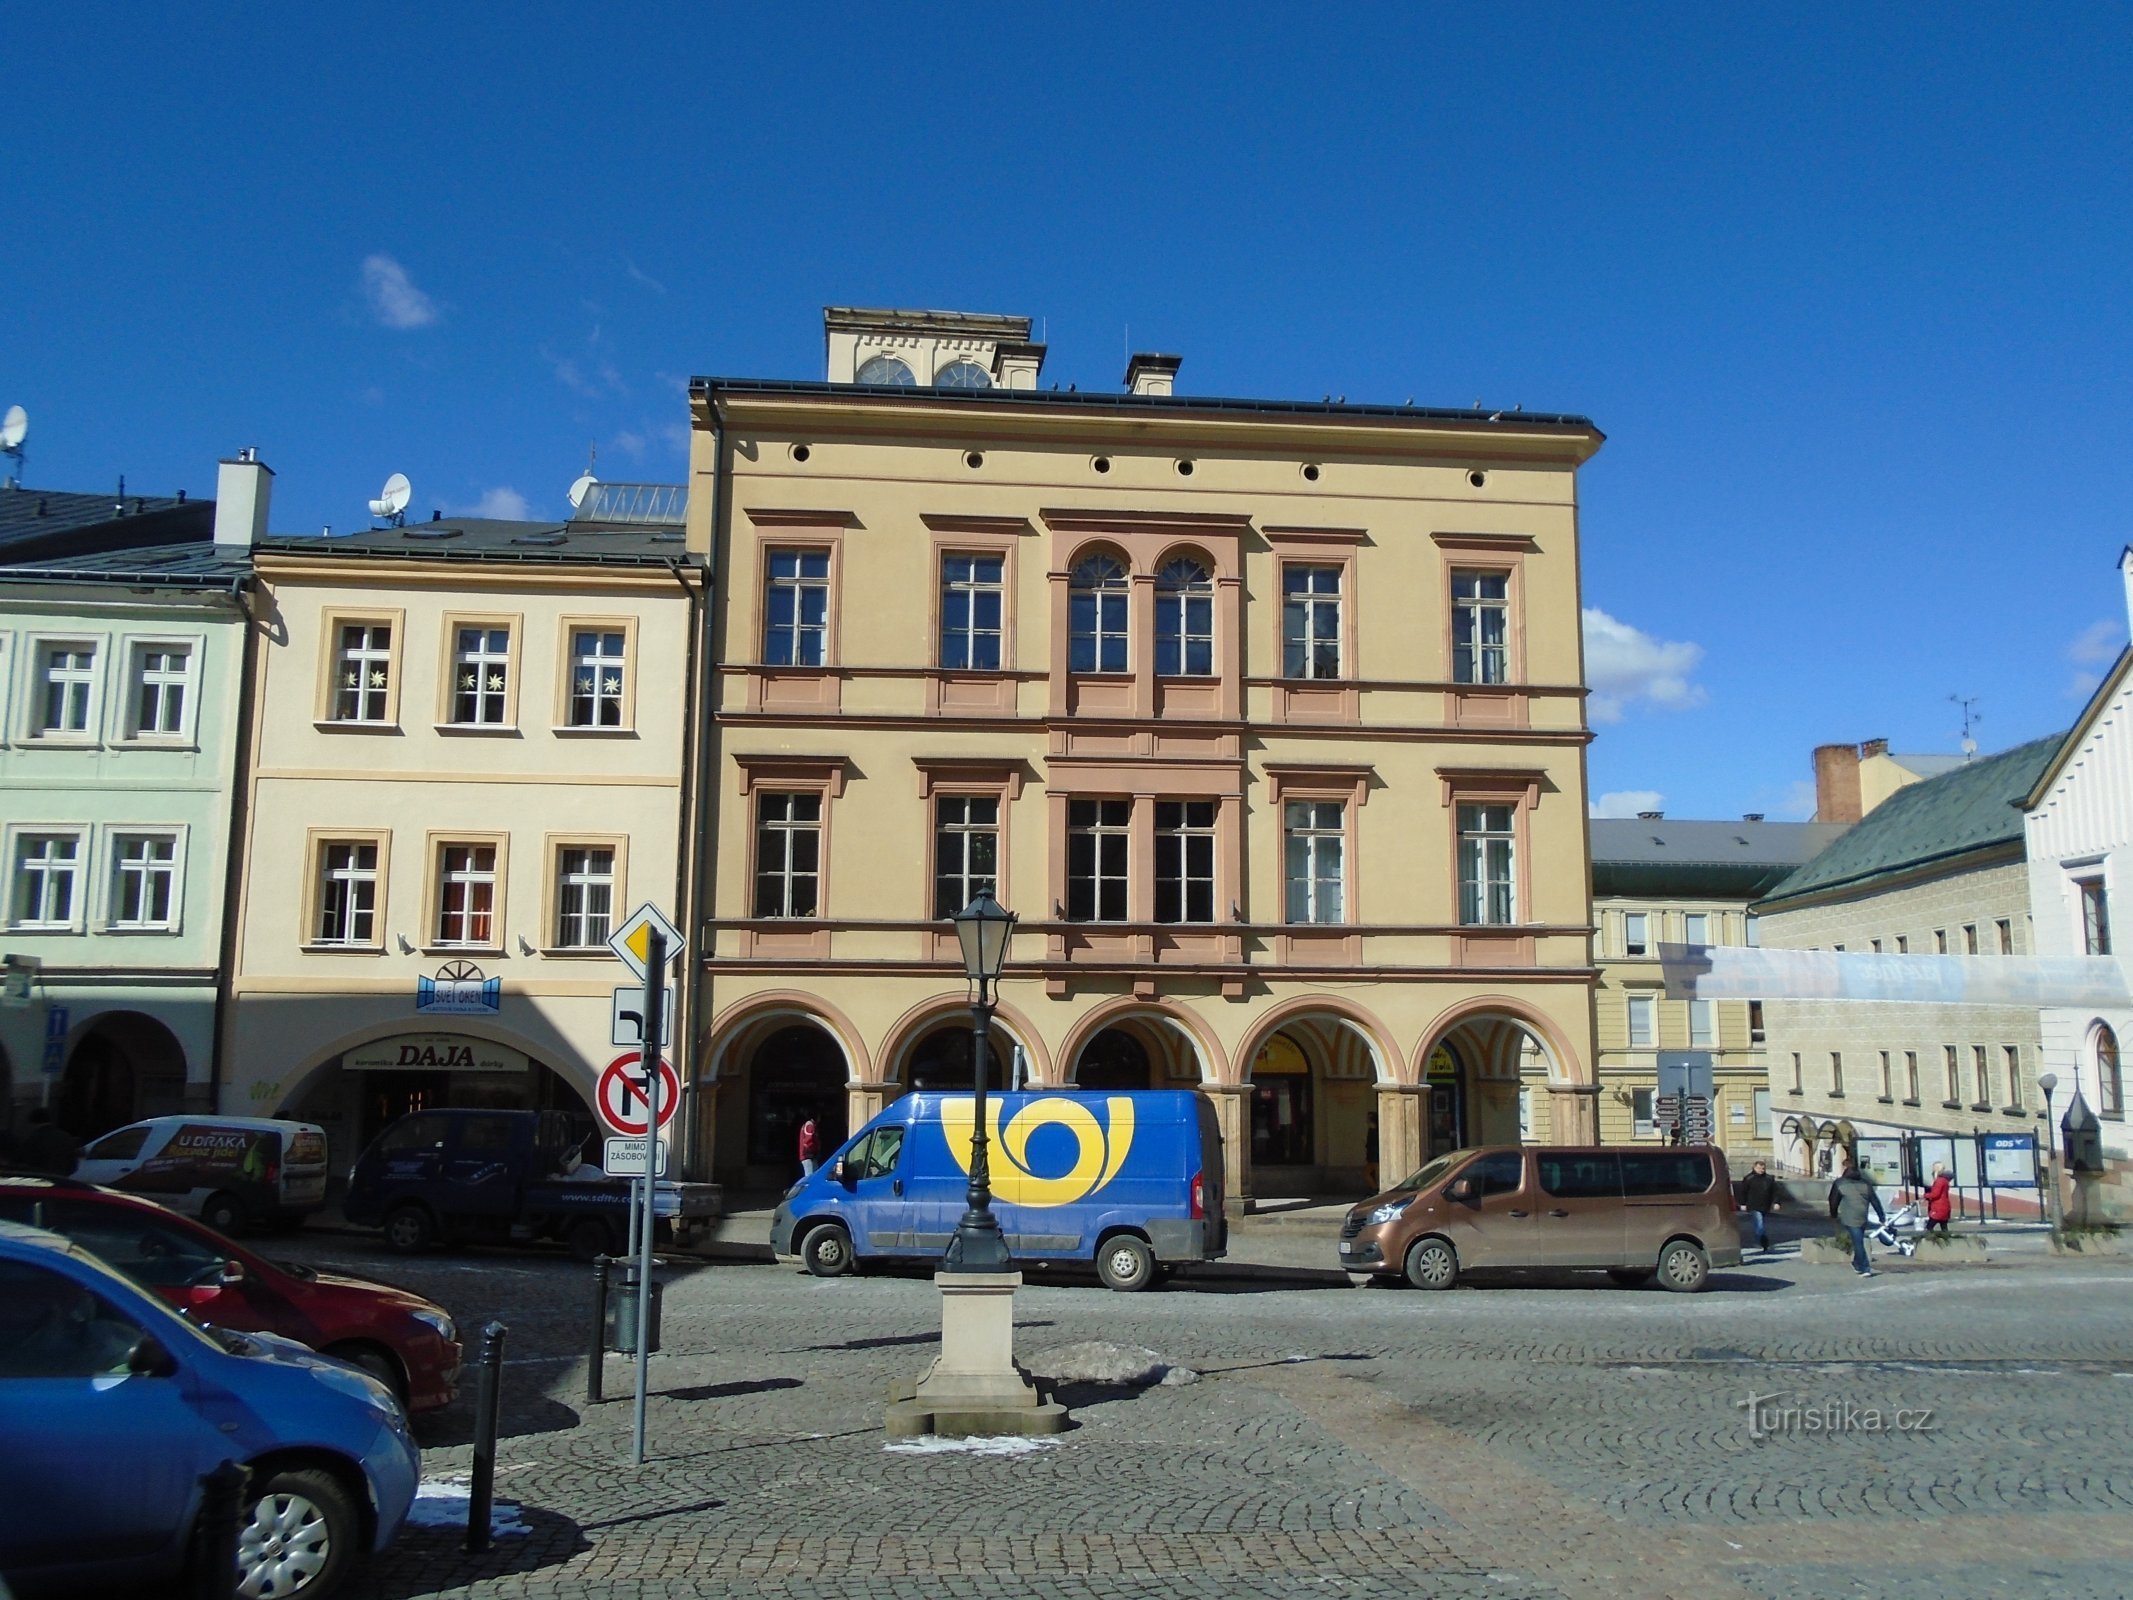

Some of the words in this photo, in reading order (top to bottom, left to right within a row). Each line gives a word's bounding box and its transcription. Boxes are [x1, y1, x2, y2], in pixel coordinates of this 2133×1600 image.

[459, 990, 481, 1003] OKEN
[396, 1045, 475, 1067] DAJA
[179, 1135, 190, 1146] U
[192, 1136, 247, 1148] DRAKA
[625, 1143, 646, 1151] MIMO
[1995, 1139, 2014, 1148] ODS
[611, 1150, 660, 1161] ZÁSOBOVÍ
